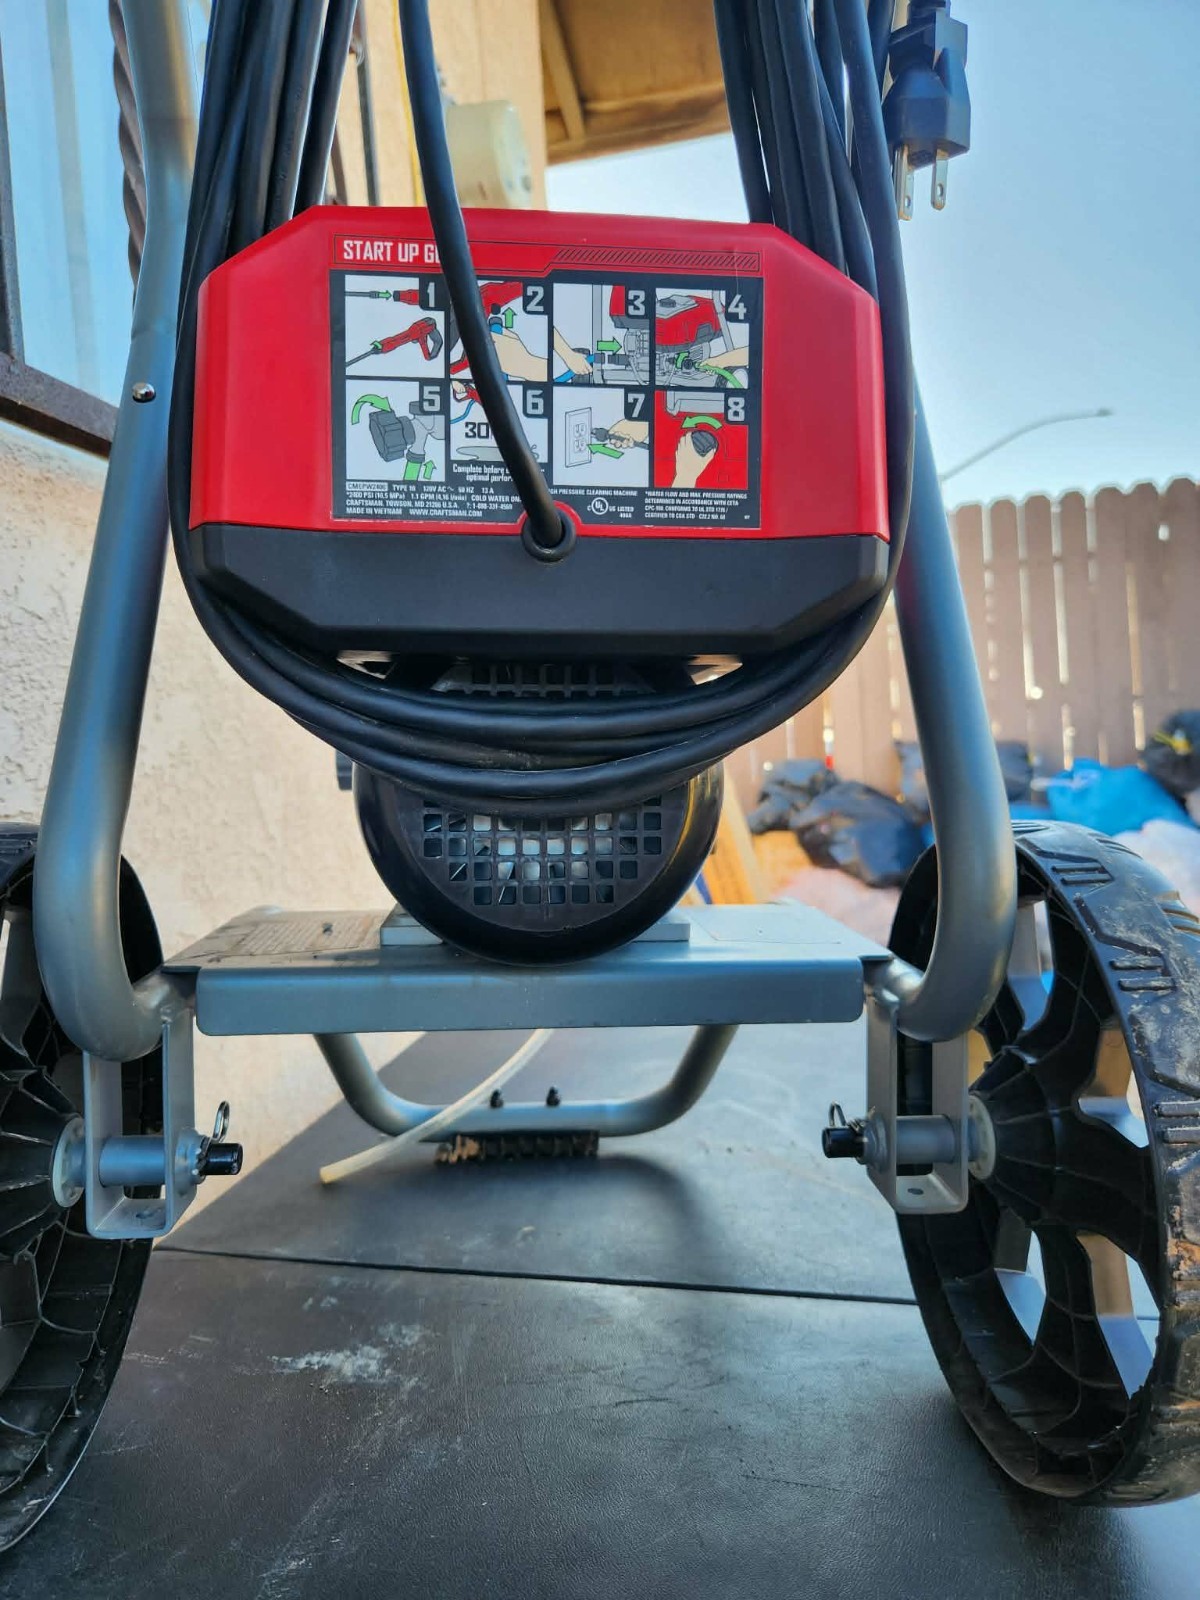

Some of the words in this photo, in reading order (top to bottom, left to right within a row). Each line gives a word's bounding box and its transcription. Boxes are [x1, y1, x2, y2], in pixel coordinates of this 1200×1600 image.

[343, 240, 393, 261] START
[397, 242, 419, 262] UP
[427, 282, 435, 307] 1
[526, 286, 544, 312] 2
[628, 290, 645, 316] 3
[728, 294, 747, 319] 4
[423, 386, 441, 411] 5
[526, 390, 544, 415] 6
[627, 393, 645, 417] 7
[728, 397, 745, 421] 8
[453, 463, 482, 475] Complete
[484, 465, 505, 475] before
[363, 491, 374, 499] PSI
[392, 484, 408, 492] TYPE
[471, 494, 487, 502] COLD
[559, 488, 585, 496] PRESSURE
[346, 507, 365, 515] MADE
[366, 507, 373, 515] IN
[595, 500, 605, 511] UL
